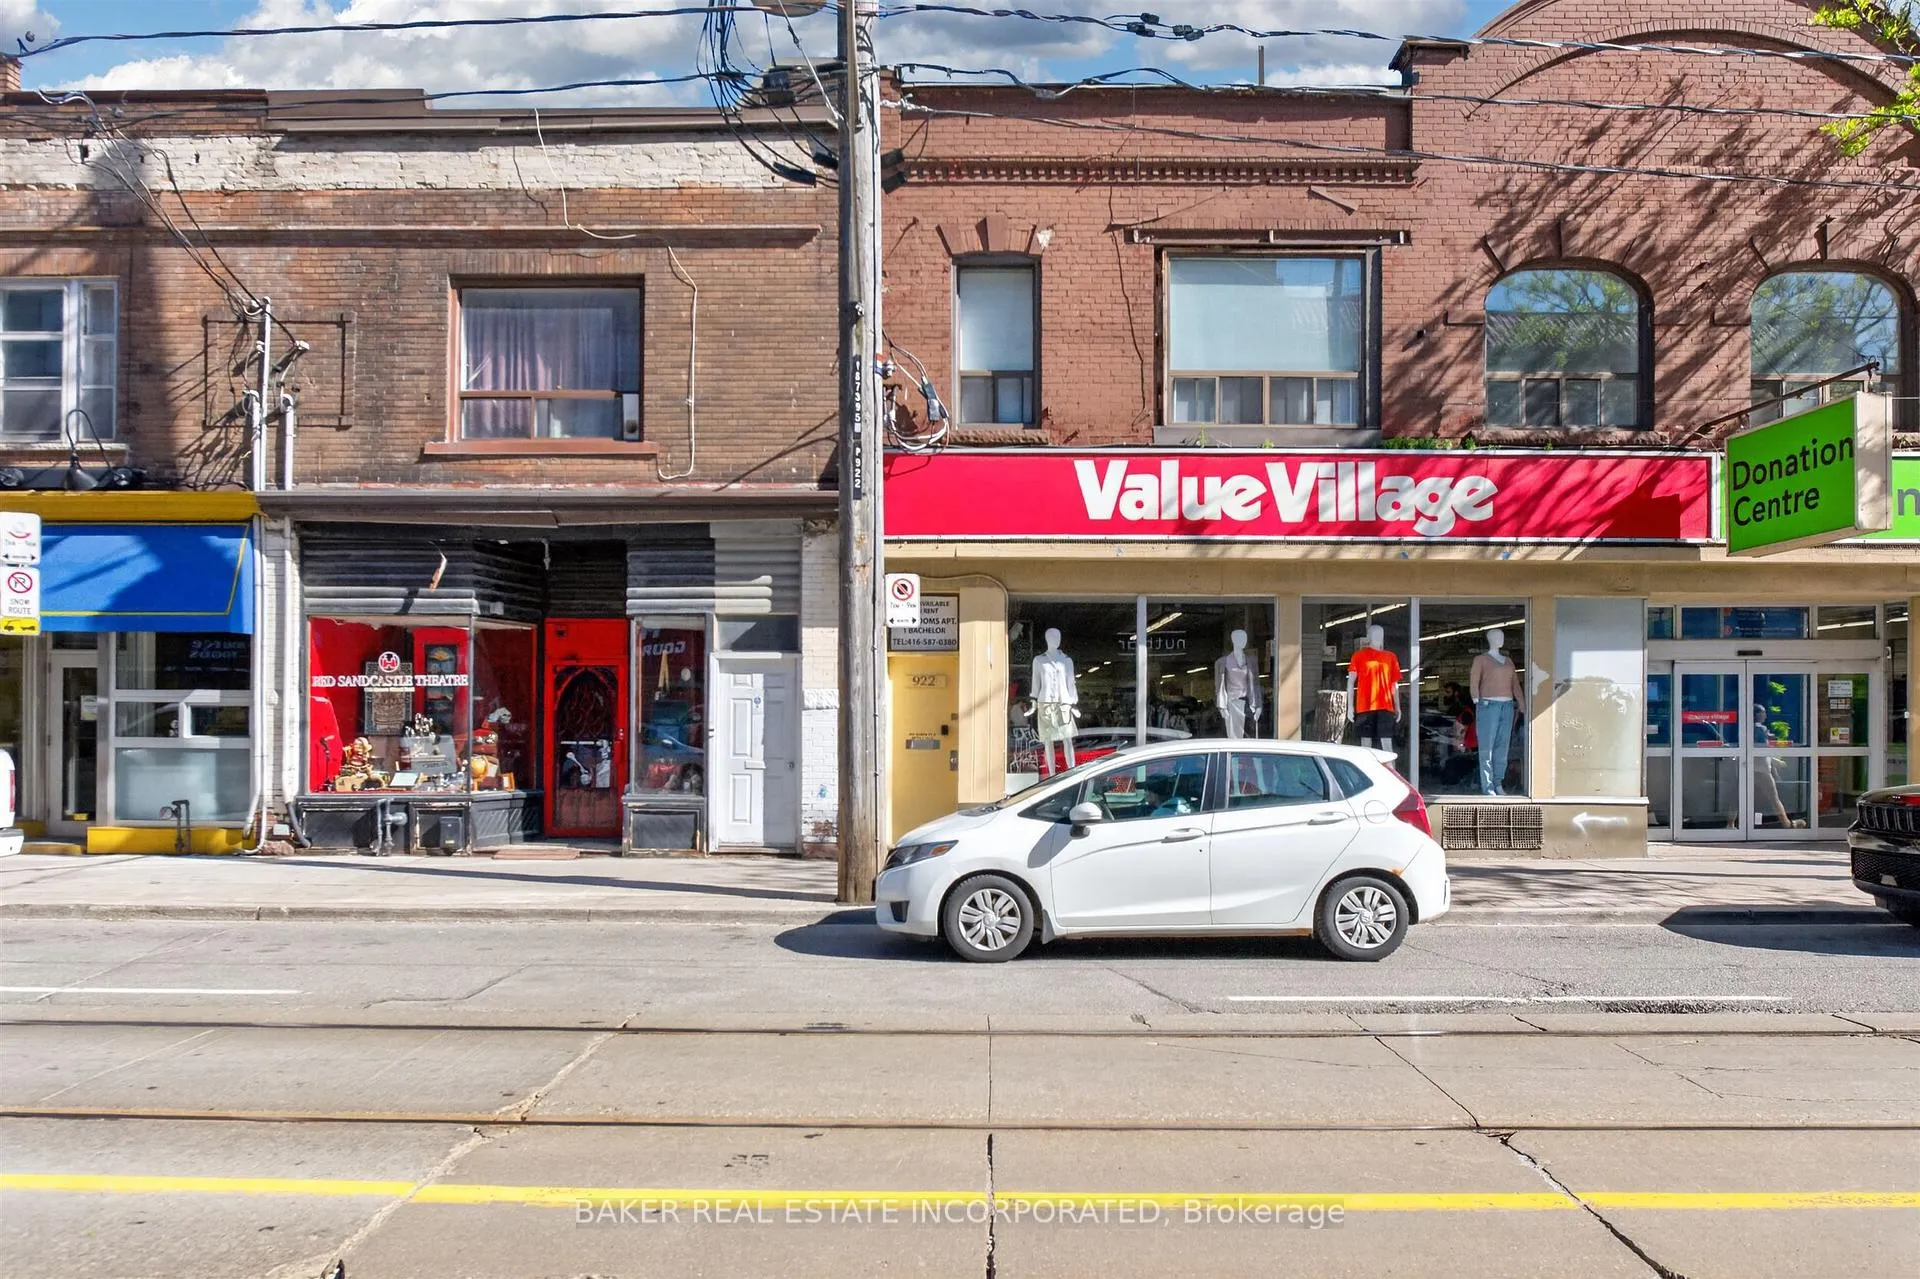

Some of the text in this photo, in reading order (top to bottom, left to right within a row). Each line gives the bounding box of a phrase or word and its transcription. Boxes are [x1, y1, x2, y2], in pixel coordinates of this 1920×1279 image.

[1732, 436, 1855, 491] Donation
[1733, 486, 1820, 526] Centre
[8, 606, 32, 615] ROUTE
[311, 674, 469, 688] RED SANDCASTLE THEATRE
[912, 674, 936, 687] 922
